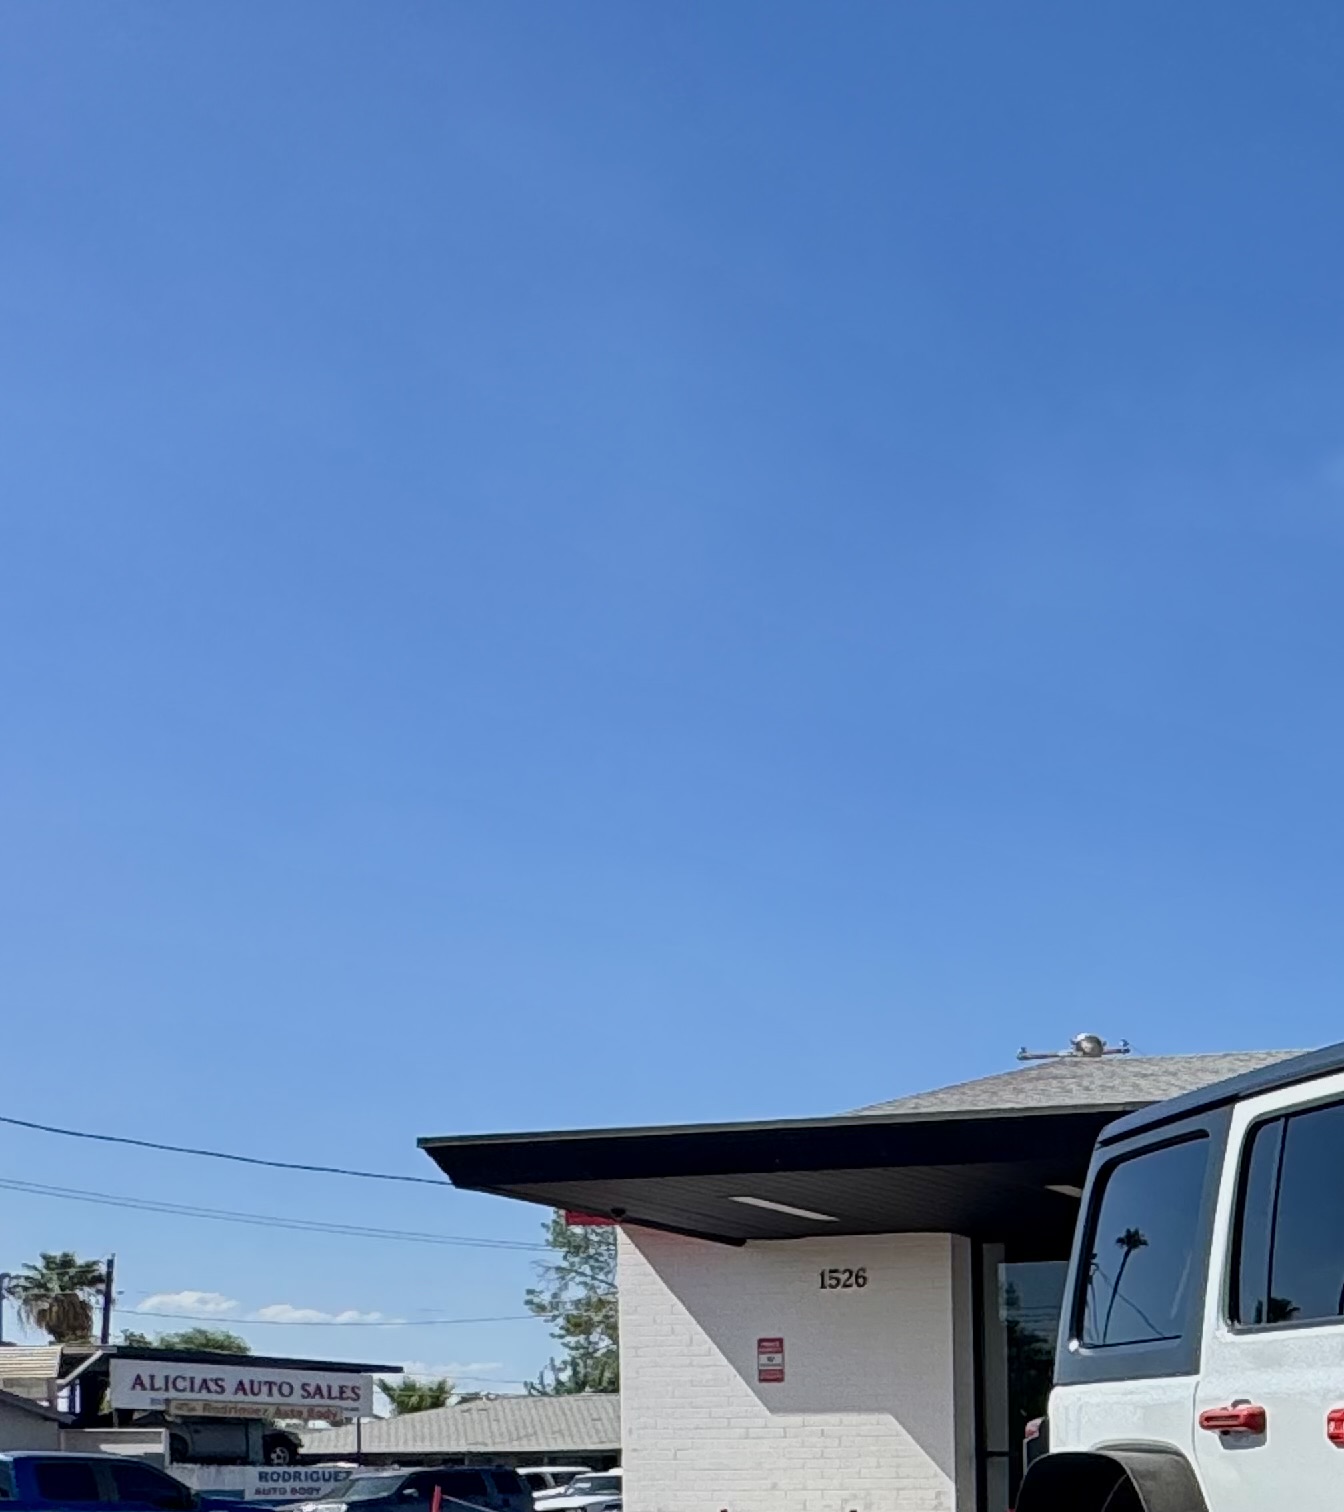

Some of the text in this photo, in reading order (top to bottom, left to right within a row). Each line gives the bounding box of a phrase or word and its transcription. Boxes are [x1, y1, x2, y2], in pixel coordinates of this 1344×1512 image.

[819, 1267, 868, 1290] 1526
[131, 1373, 361, 1401] ALICIA'S AUTO SALES
[254, 1487, 287, 1496] AUTO
